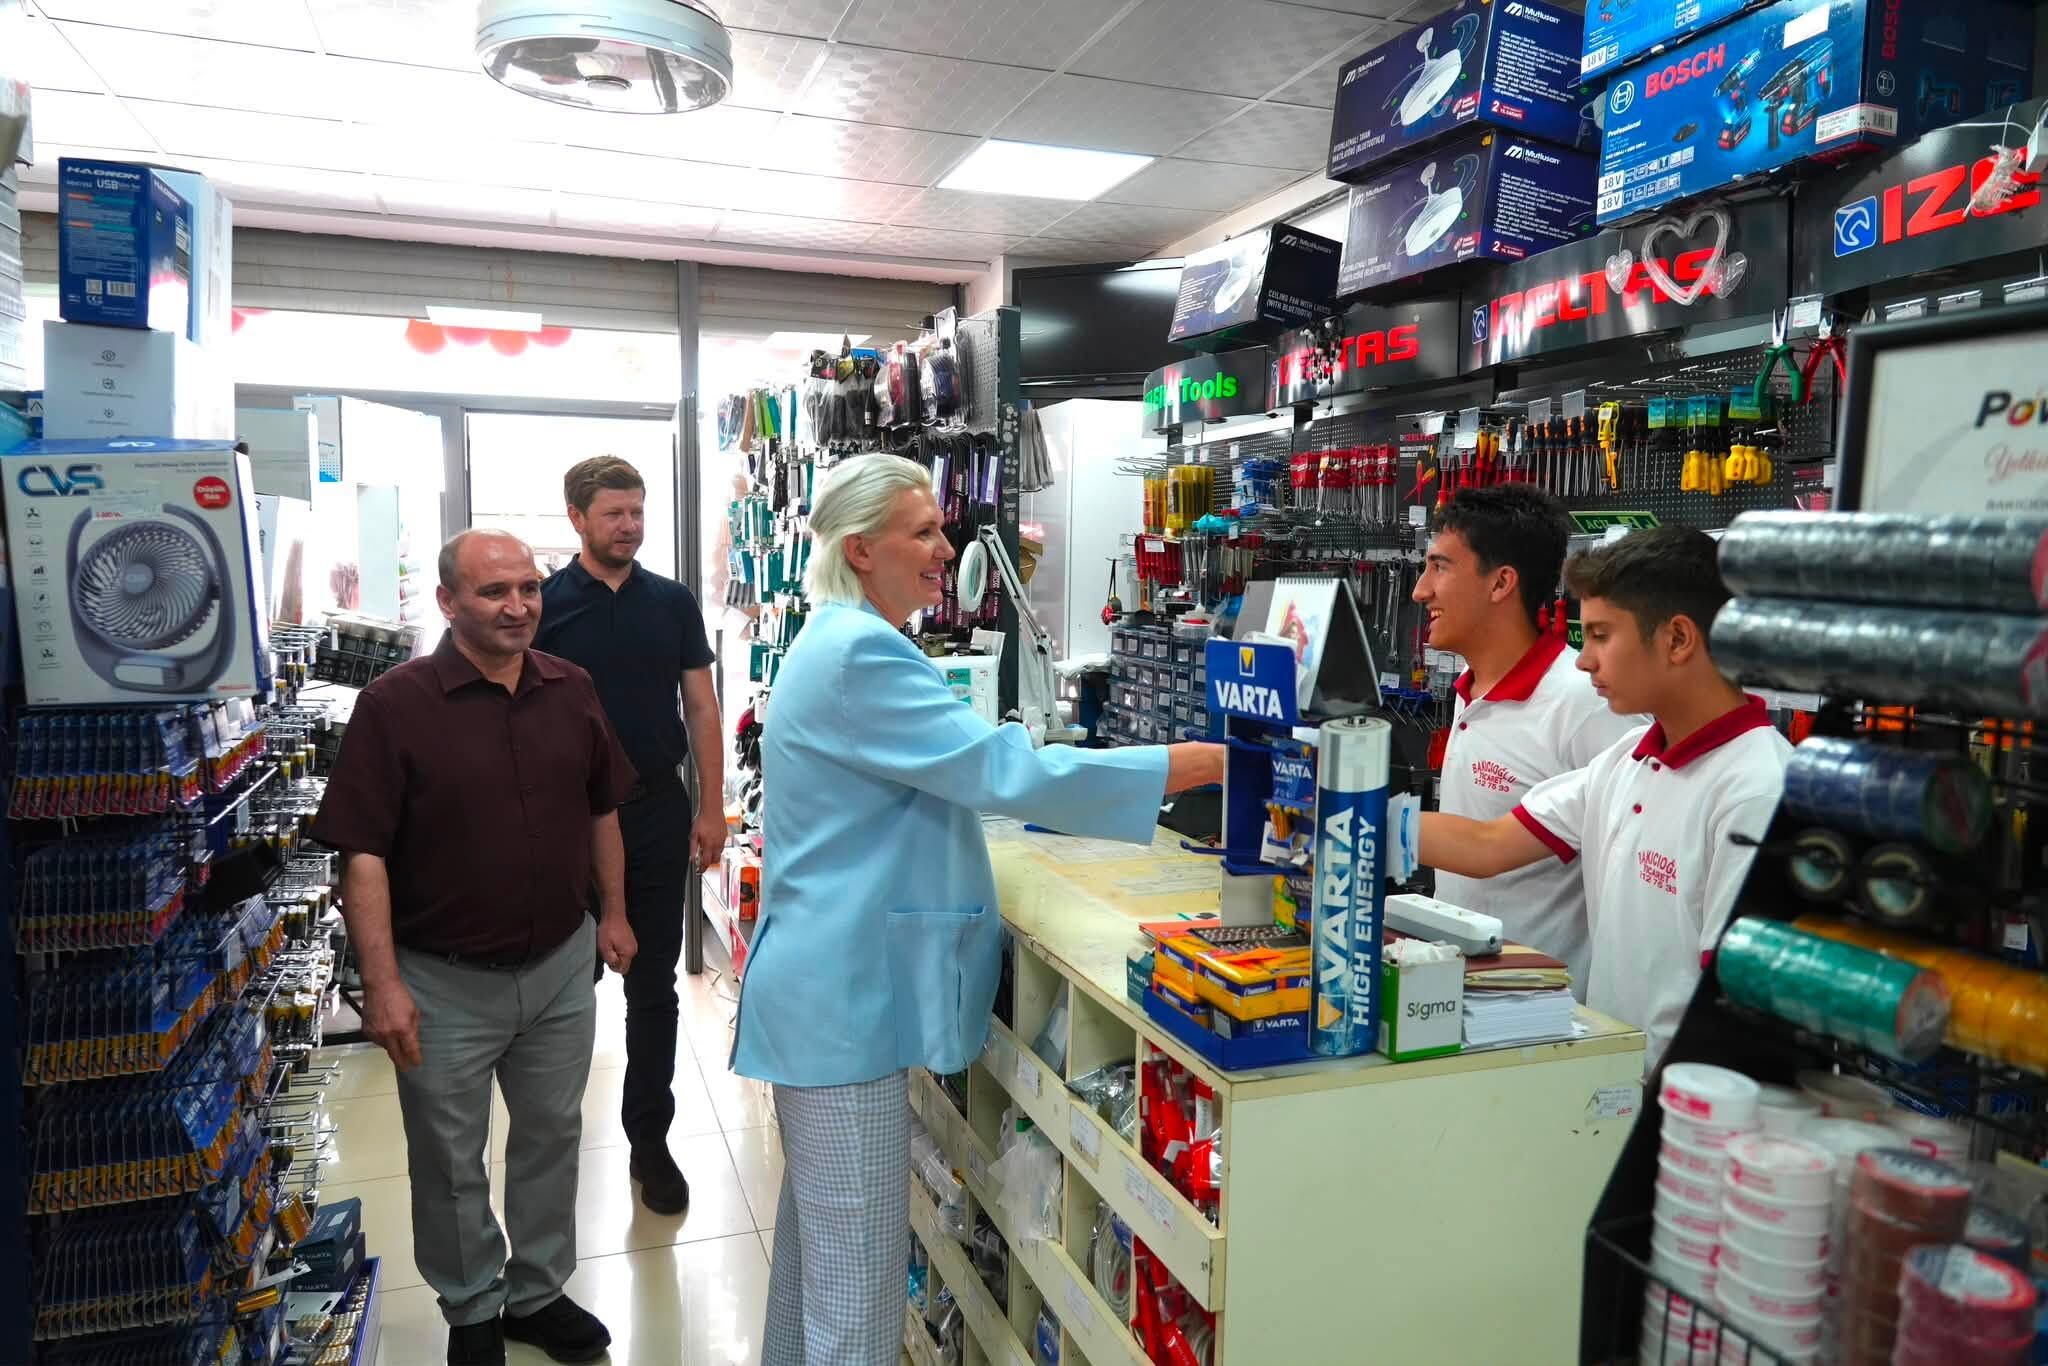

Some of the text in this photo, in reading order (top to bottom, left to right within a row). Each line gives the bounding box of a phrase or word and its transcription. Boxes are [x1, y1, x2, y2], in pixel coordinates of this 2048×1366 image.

[1645, 43, 1726, 98] BOSCH
[97, 178, 119, 190] USB
[1181, 372, 1238, 403] Tools
[18, 463, 104, 497] CVS
[1215, 680, 1283, 720] VARTA
[1272, 760, 1312, 779] VARTA
[1320, 806, 1354, 984] VARTA
[1352, 815, 1377, 1027] HIGH ENERGY
[1265, 1018, 1300, 1028] VARTA
[1407, 1000, 1456, 1021] Sigma
